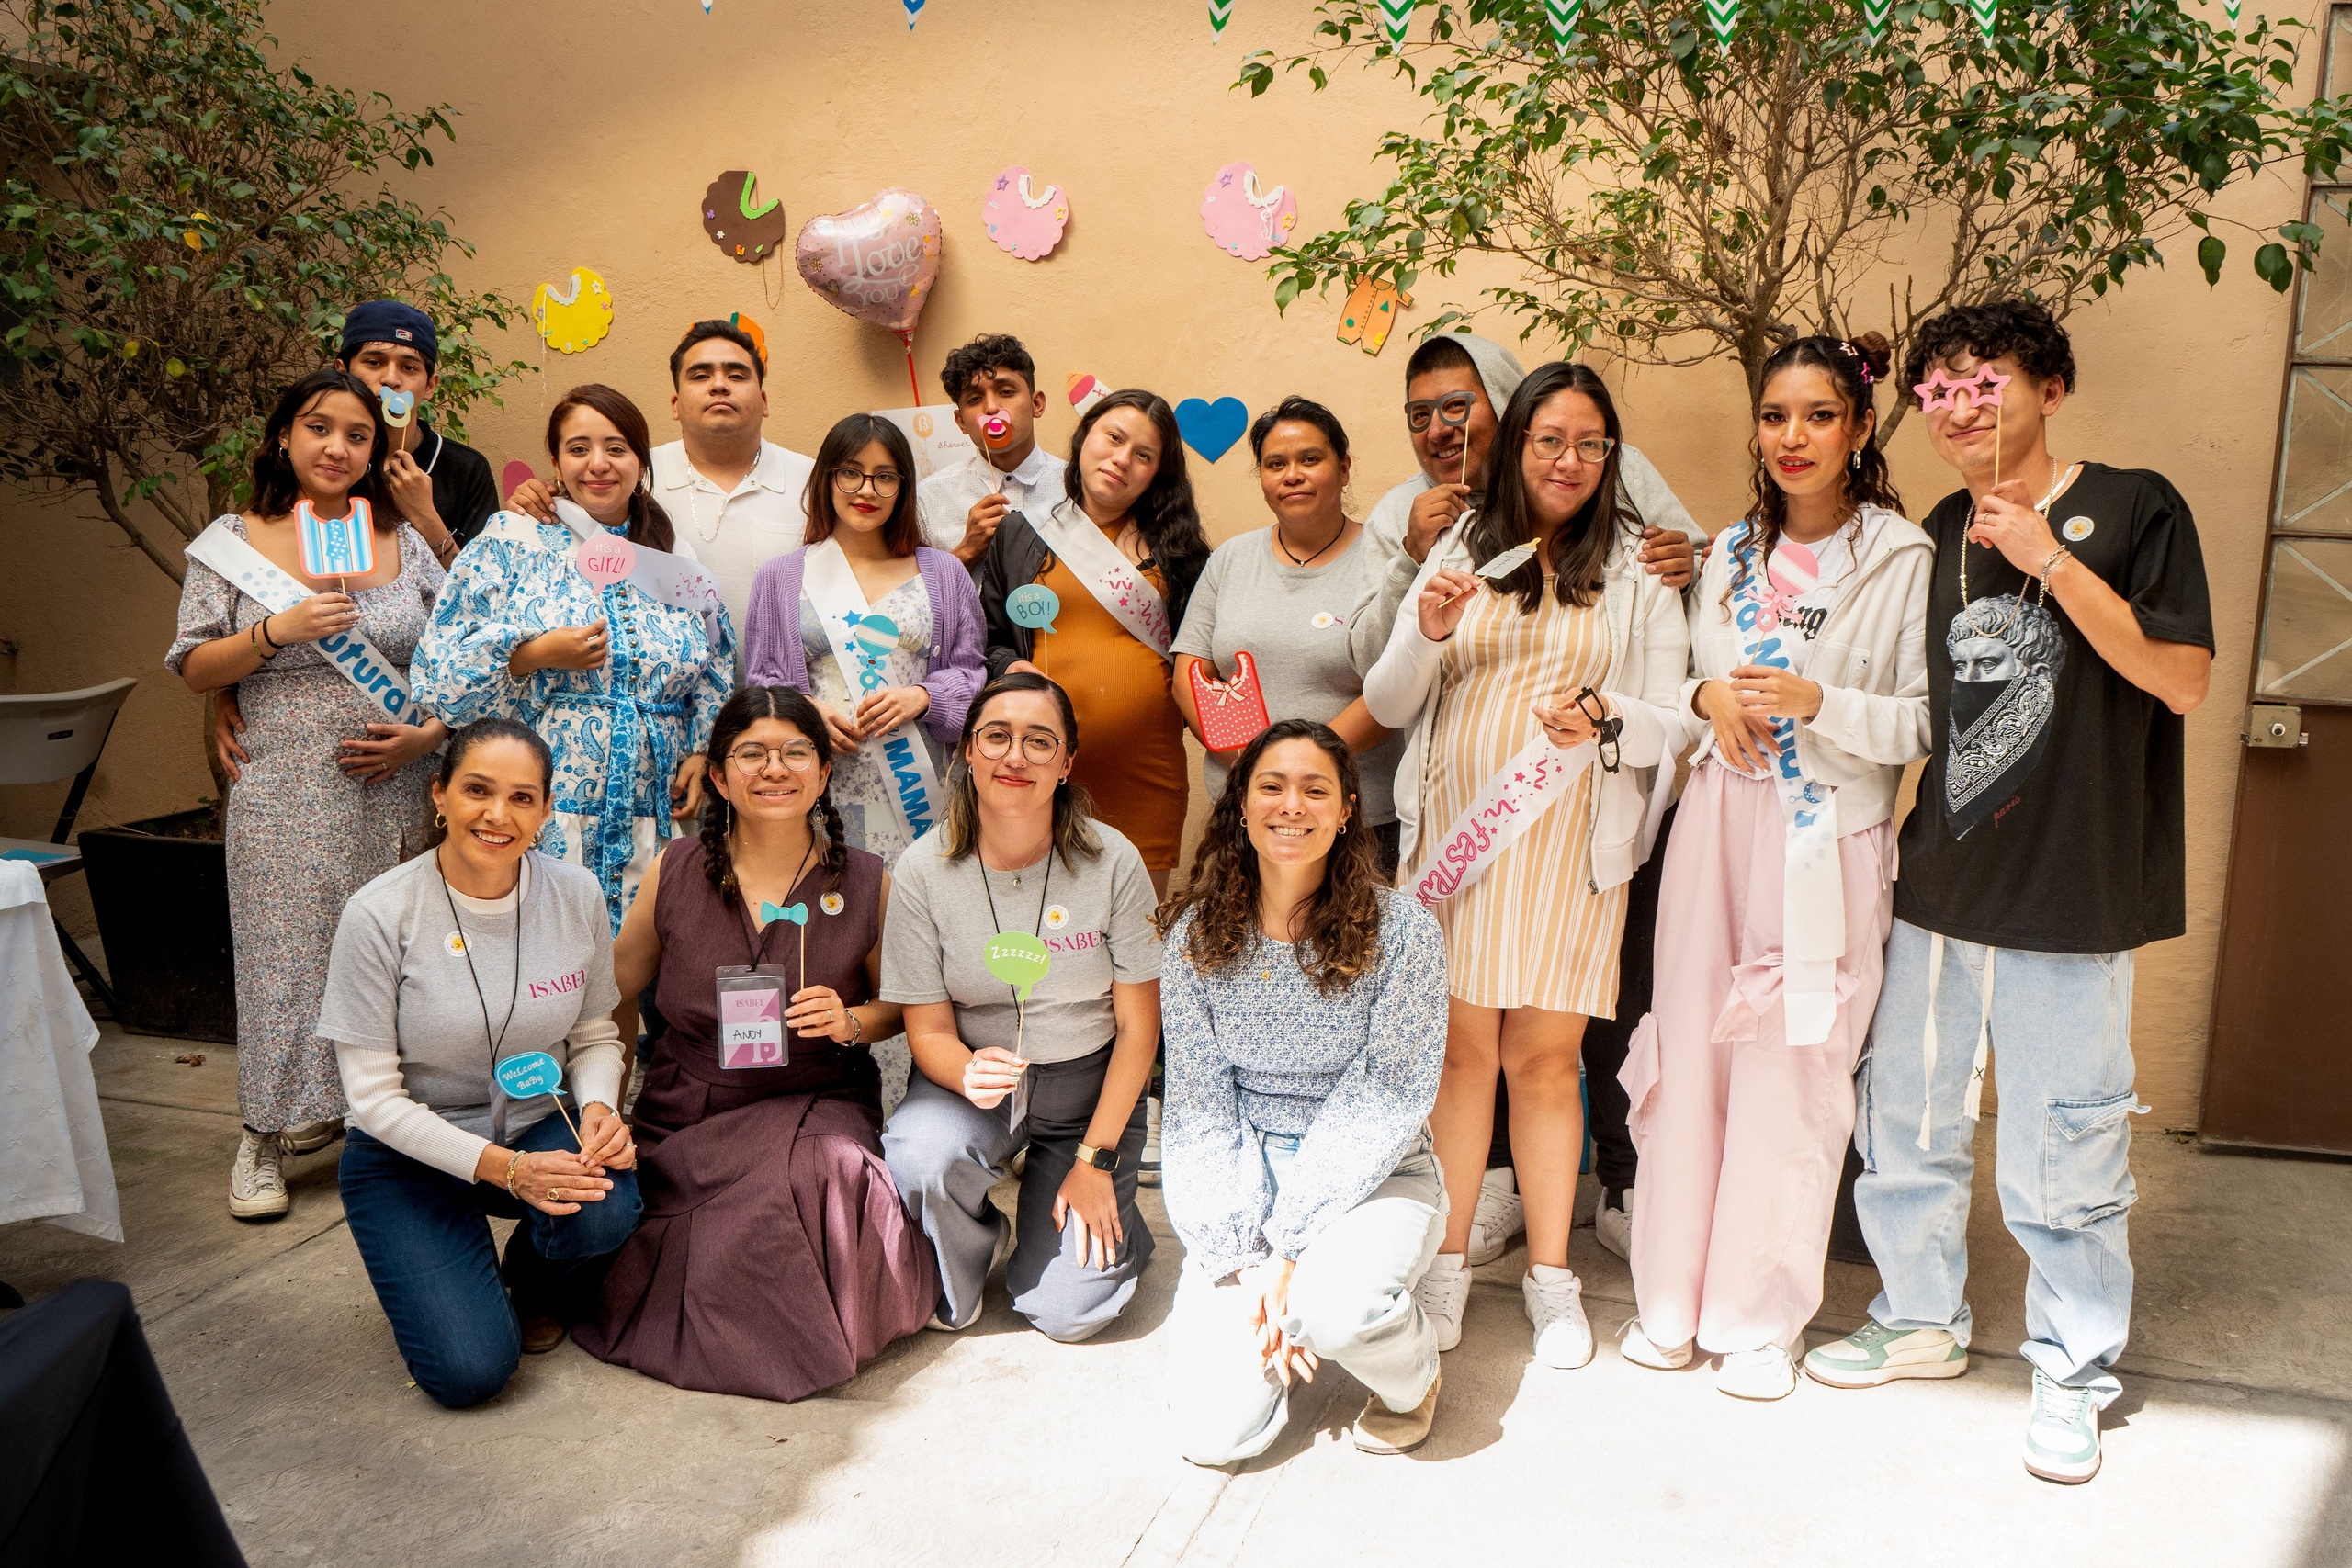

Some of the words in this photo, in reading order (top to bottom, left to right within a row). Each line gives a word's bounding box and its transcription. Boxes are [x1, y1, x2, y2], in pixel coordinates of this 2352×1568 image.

[842, 227, 922, 294] Love
[854, 283, 899, 306] YOU
[615, 546, 621, 554] a
[1016, 601, 1050, 620] BOY!
[319, 635, 406, 716] utura
[733, 1030, 762, 1040] ANDY
